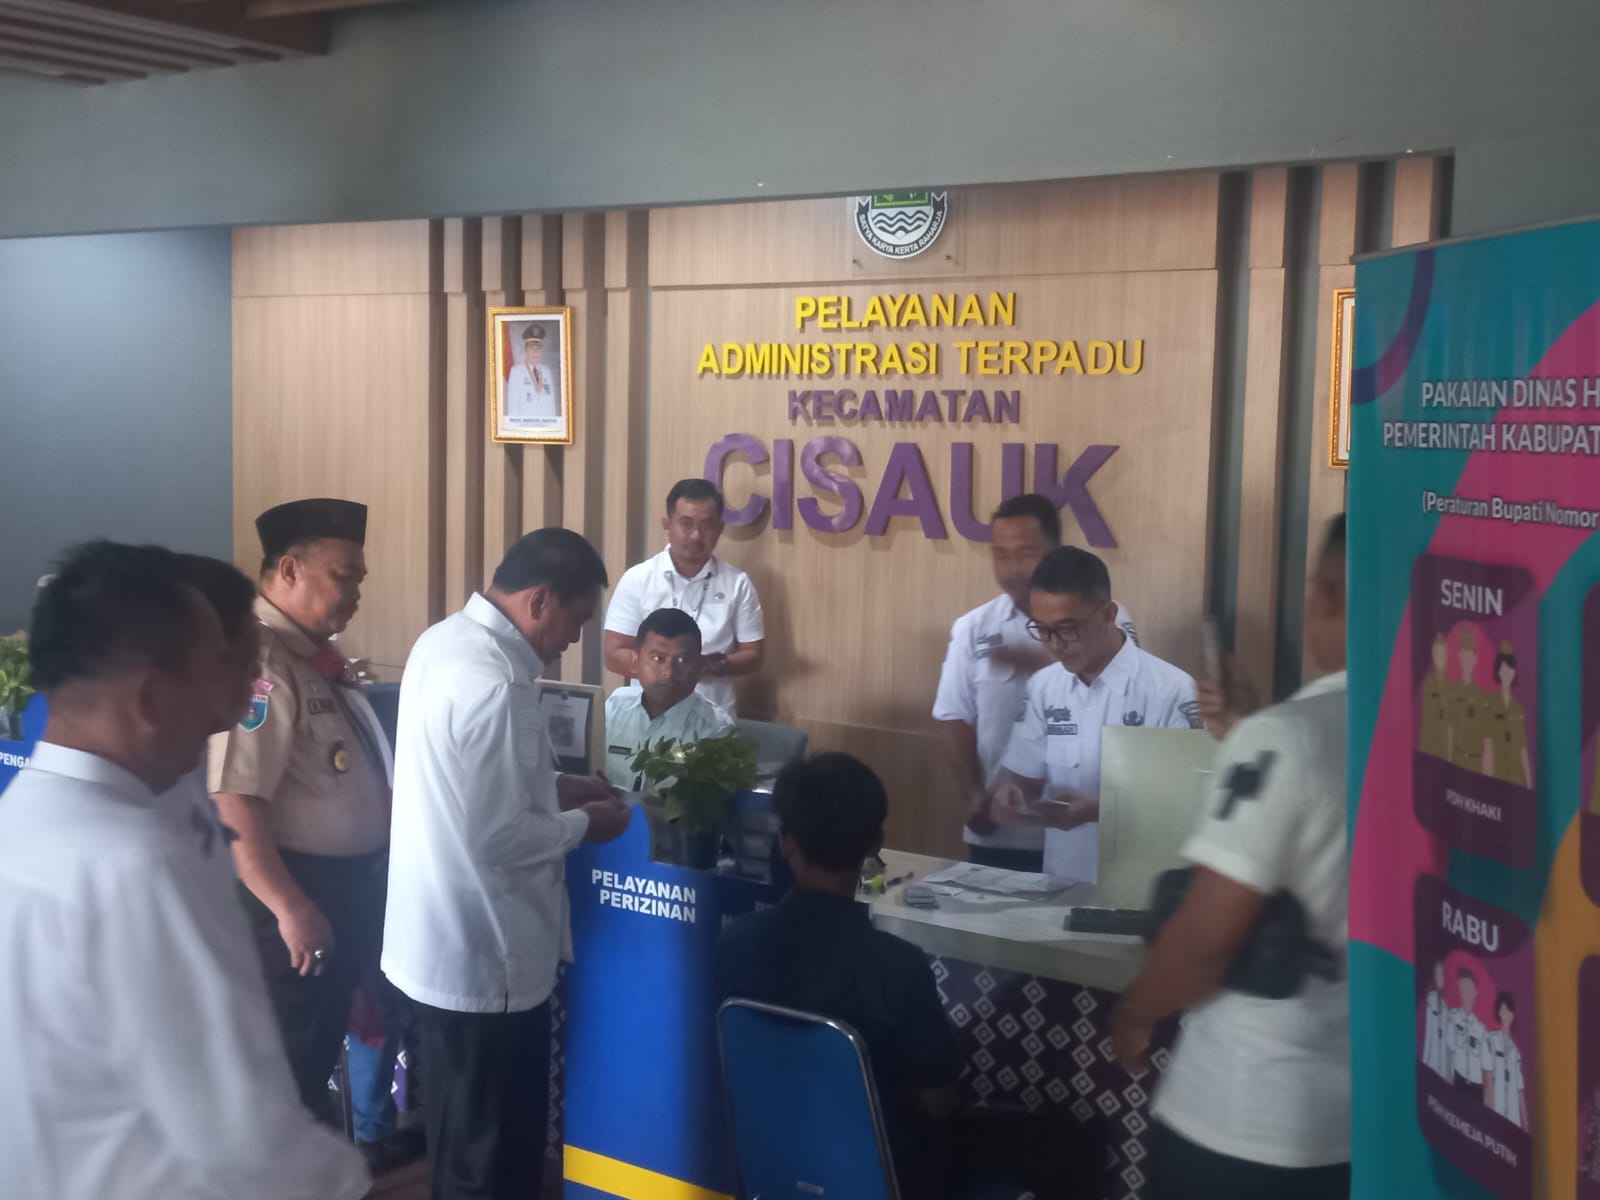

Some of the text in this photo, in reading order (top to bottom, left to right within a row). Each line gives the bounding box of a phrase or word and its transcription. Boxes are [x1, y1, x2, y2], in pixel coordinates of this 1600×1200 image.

[859, 210, 943, 255] SATYA KARYA KERTA RAHARJA
[795, 292, 1016, 329] PELAYANAN
[697, 339, 1145, 375] ADMINISTRASI TERPADU
[787, 389, 1021, 424] KECAMATAN
[1421, 379, 1508, 408] PAKAIAN
[1513, 378, 1577, 409] DINAS
[1383, 422, 1600, 455] PEMERINTAH KABUPAT
[704, 433, 1120, 549] CISAUK
[1422, 490, 1599, 529] (Peraturan Bupati Nomor
[1441, 578, 1504, 616] SENIN
[1464, 798, 1502, 823] KHAKI
[591, 869, 696, 904] PELAYANAN
[600, 889, 696, 923] PERIZINAN
[1442, 900, 1499, 952] RABU
[1484, 1134, 1518, 1168] PUTIH
